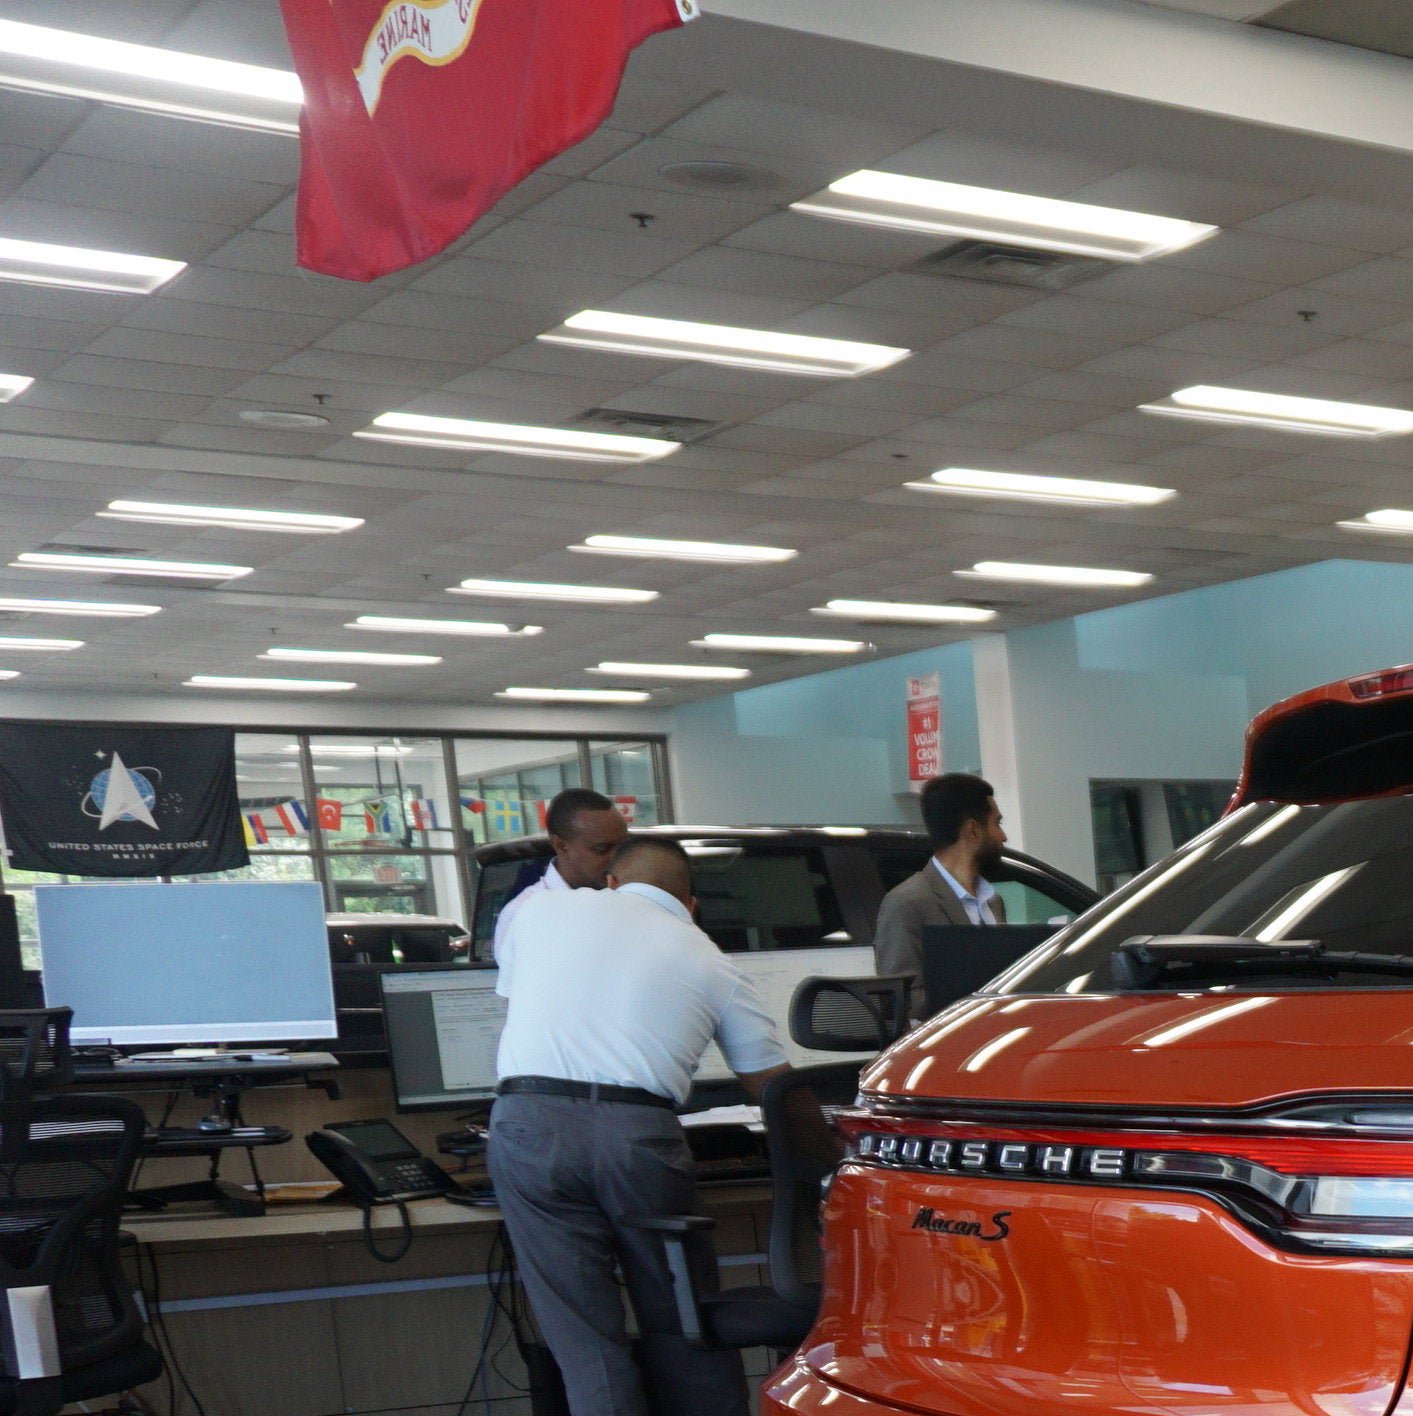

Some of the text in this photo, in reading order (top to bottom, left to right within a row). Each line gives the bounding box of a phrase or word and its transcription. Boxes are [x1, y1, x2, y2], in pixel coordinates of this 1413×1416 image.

[48, 840, 209, 851] UNITED STATES SPACE FORCE
[877, 1138, 1125, 1176] PORSCHE
[911, 1205, 1012, 1241] Macan S
